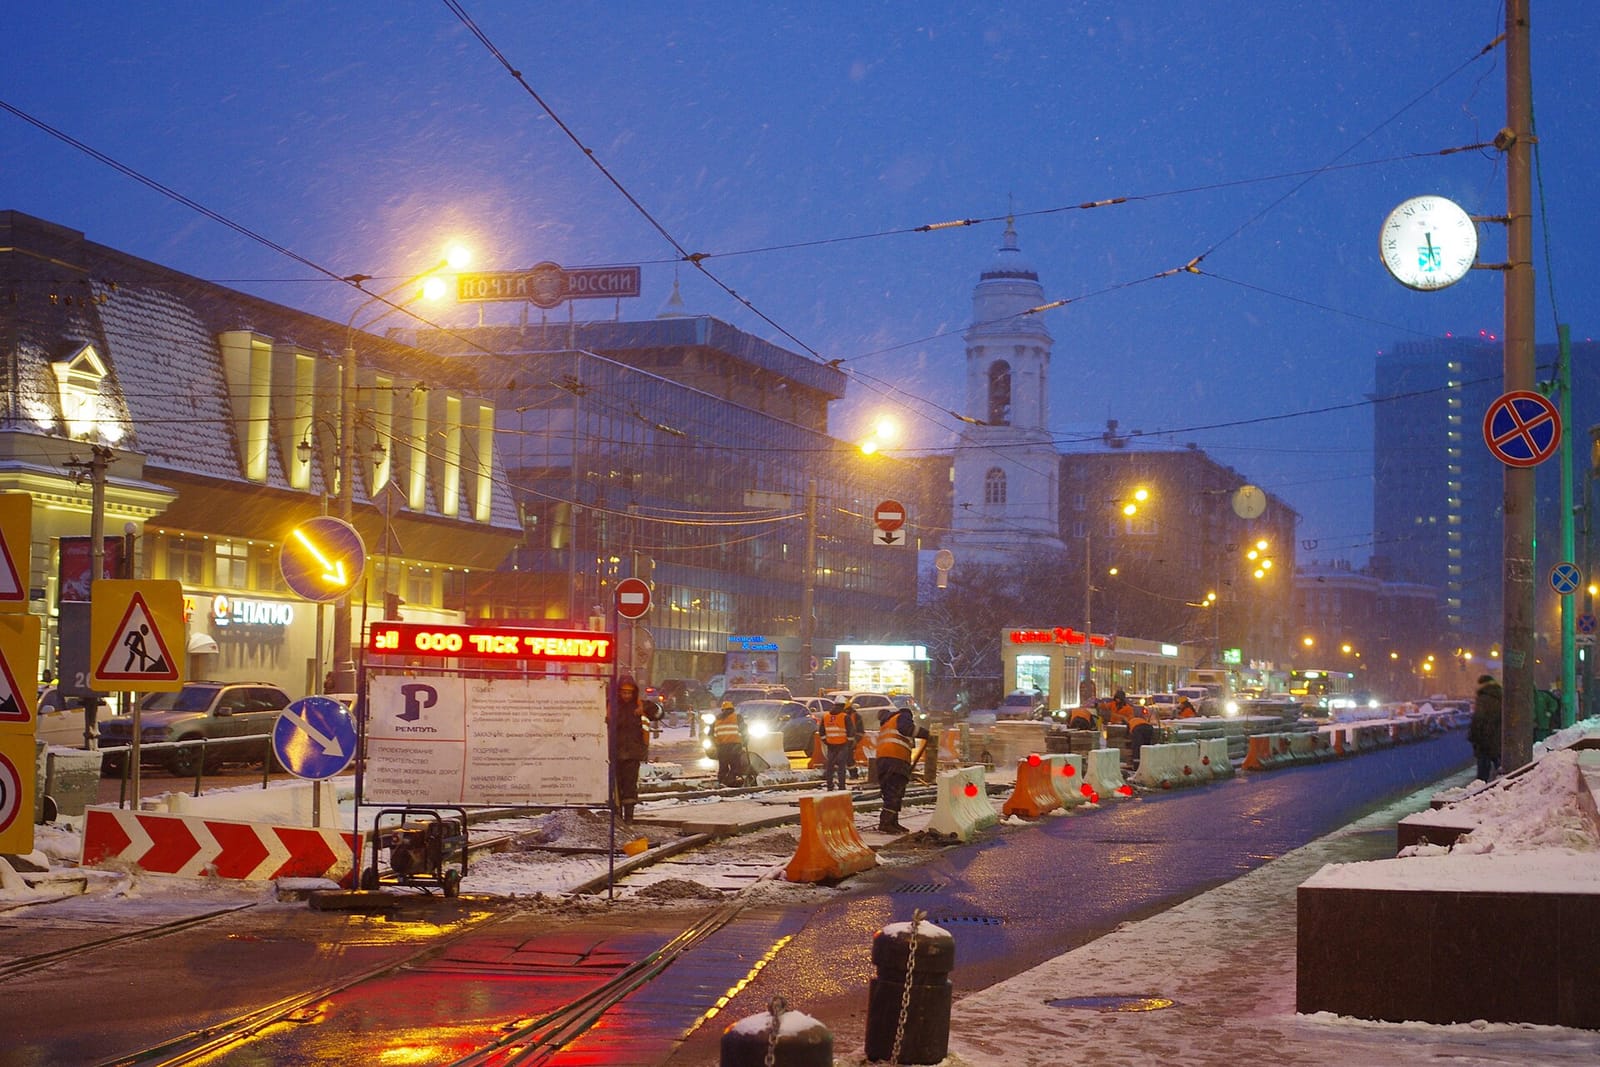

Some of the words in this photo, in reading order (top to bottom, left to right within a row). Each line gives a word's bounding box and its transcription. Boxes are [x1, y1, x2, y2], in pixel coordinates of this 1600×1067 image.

[463, 277, 528, 298] ПОЧТА
[568, 273, 631, 293] РОССИИ
[243, 601, 294, 626] ПАТИО
[415, 632, 463, 651] ООО
